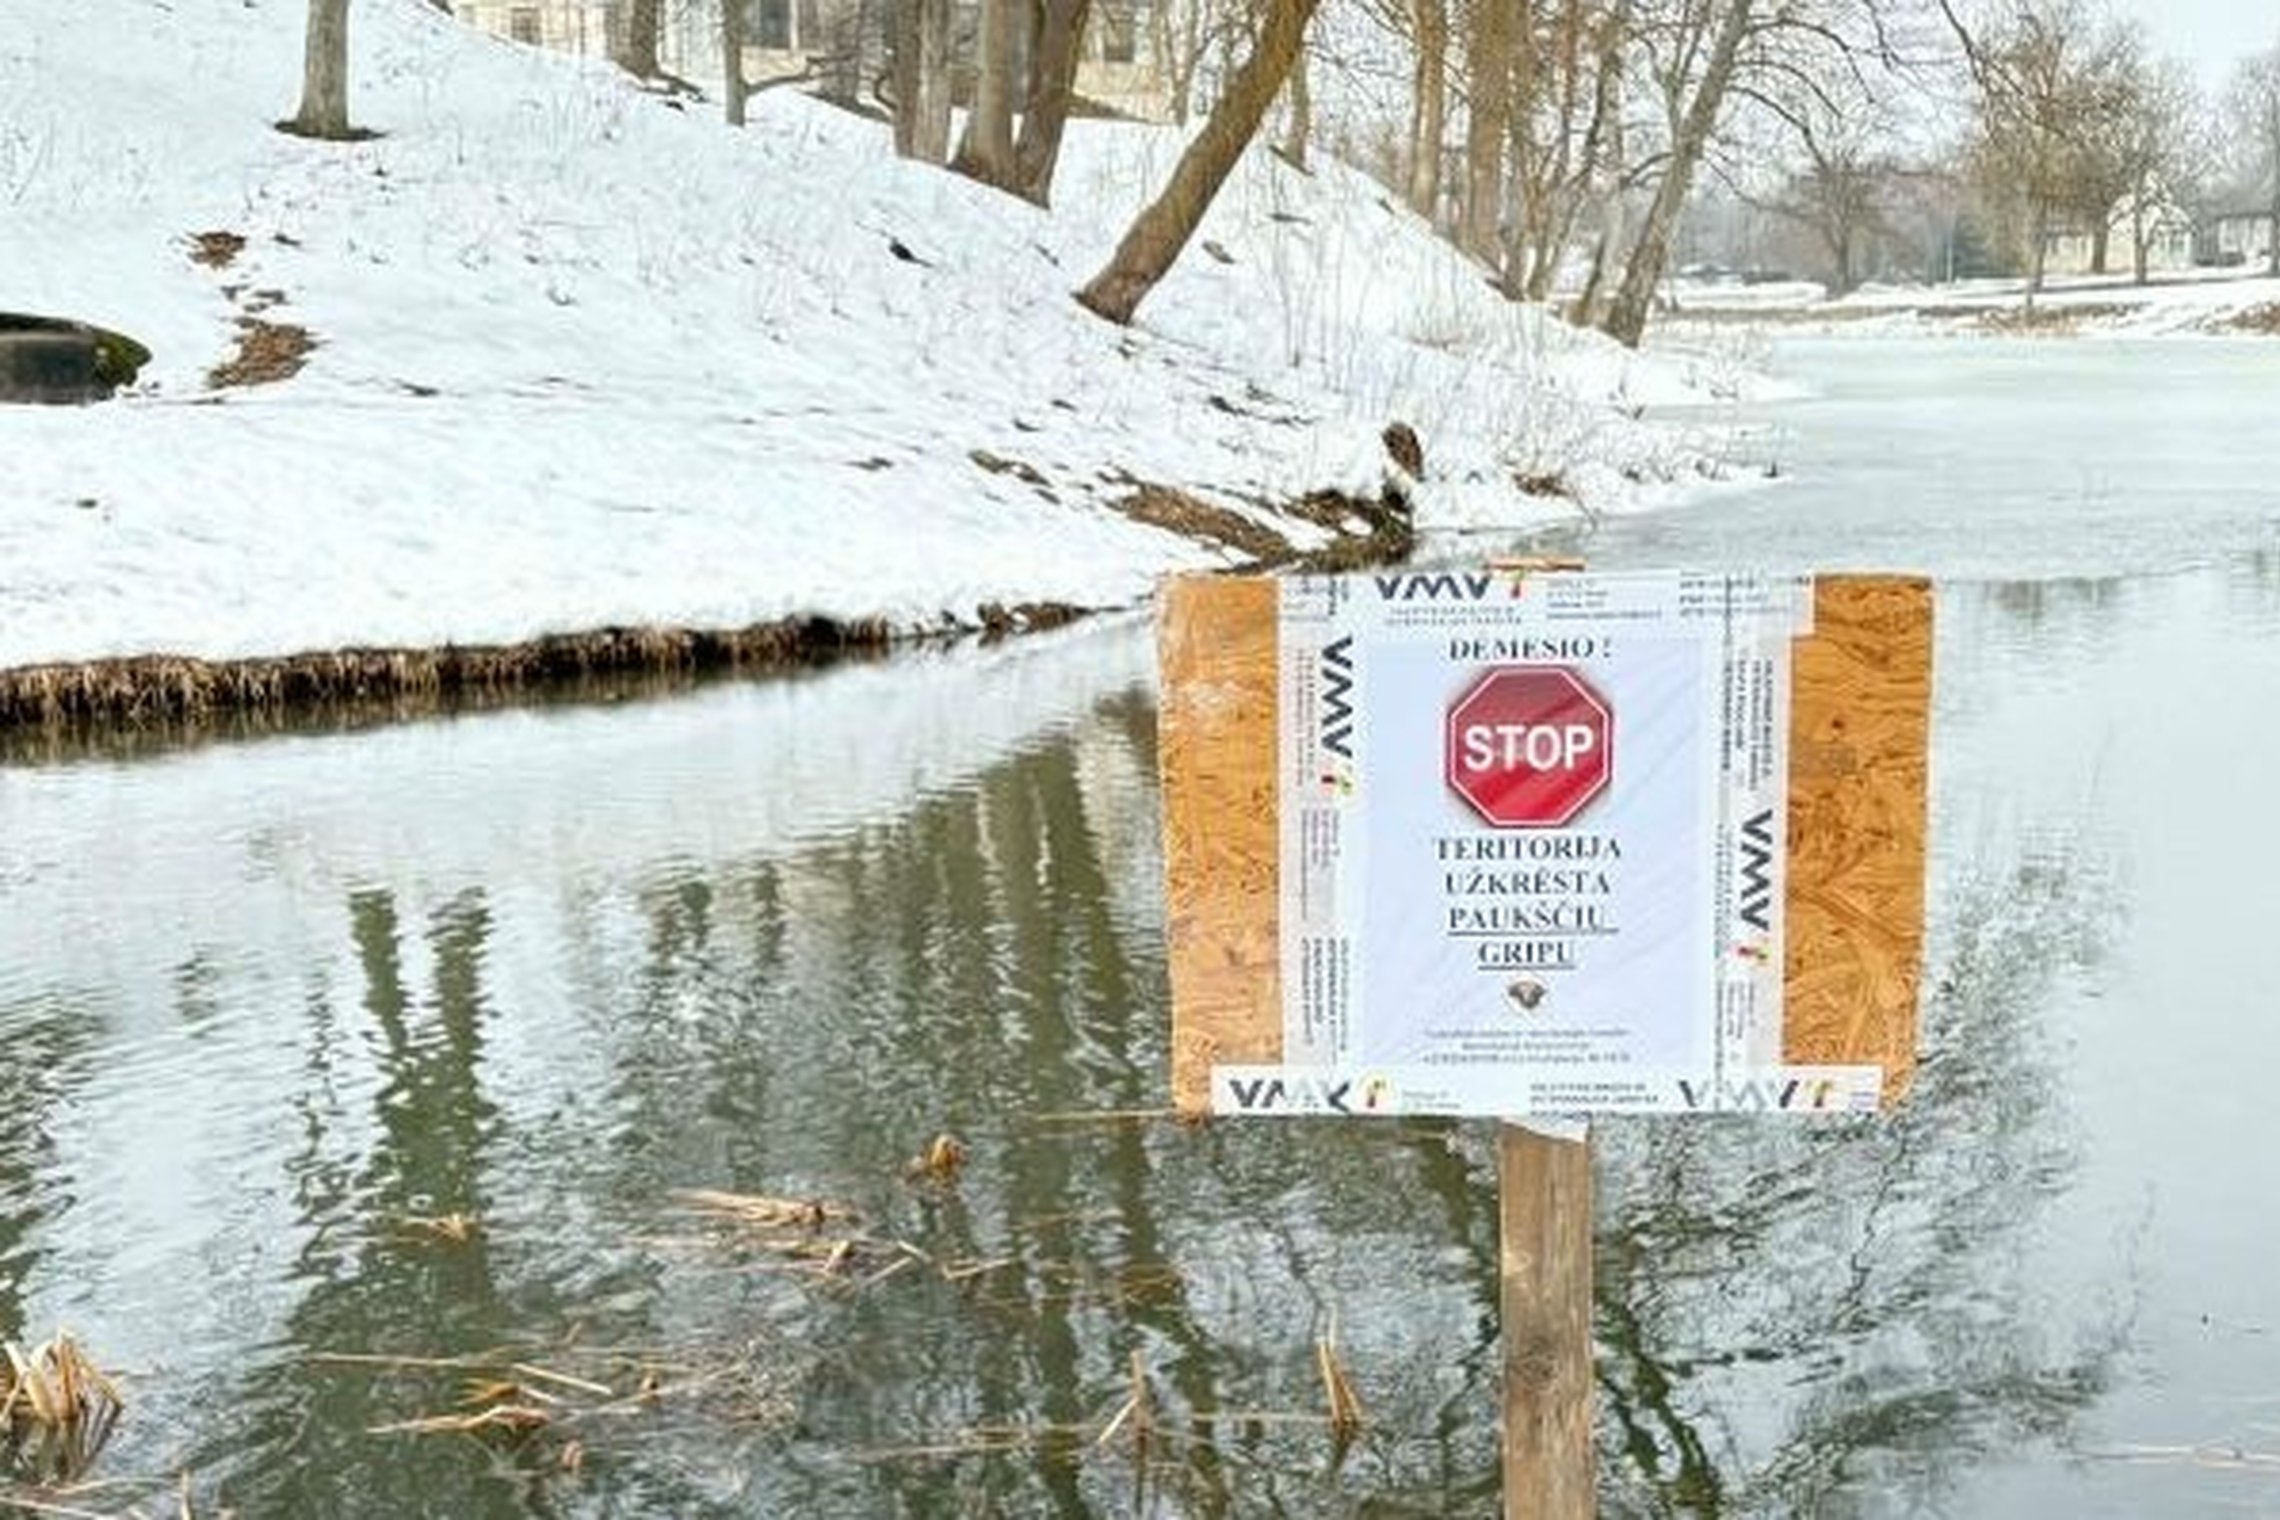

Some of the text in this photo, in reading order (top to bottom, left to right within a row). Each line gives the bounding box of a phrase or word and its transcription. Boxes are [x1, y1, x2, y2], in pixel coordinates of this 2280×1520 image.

[1464, 724, 1594, 771] STOP
[1434, 835, 1621, 860] TERITORIJA
[1478, 942, 1575, 963] GRIPU
